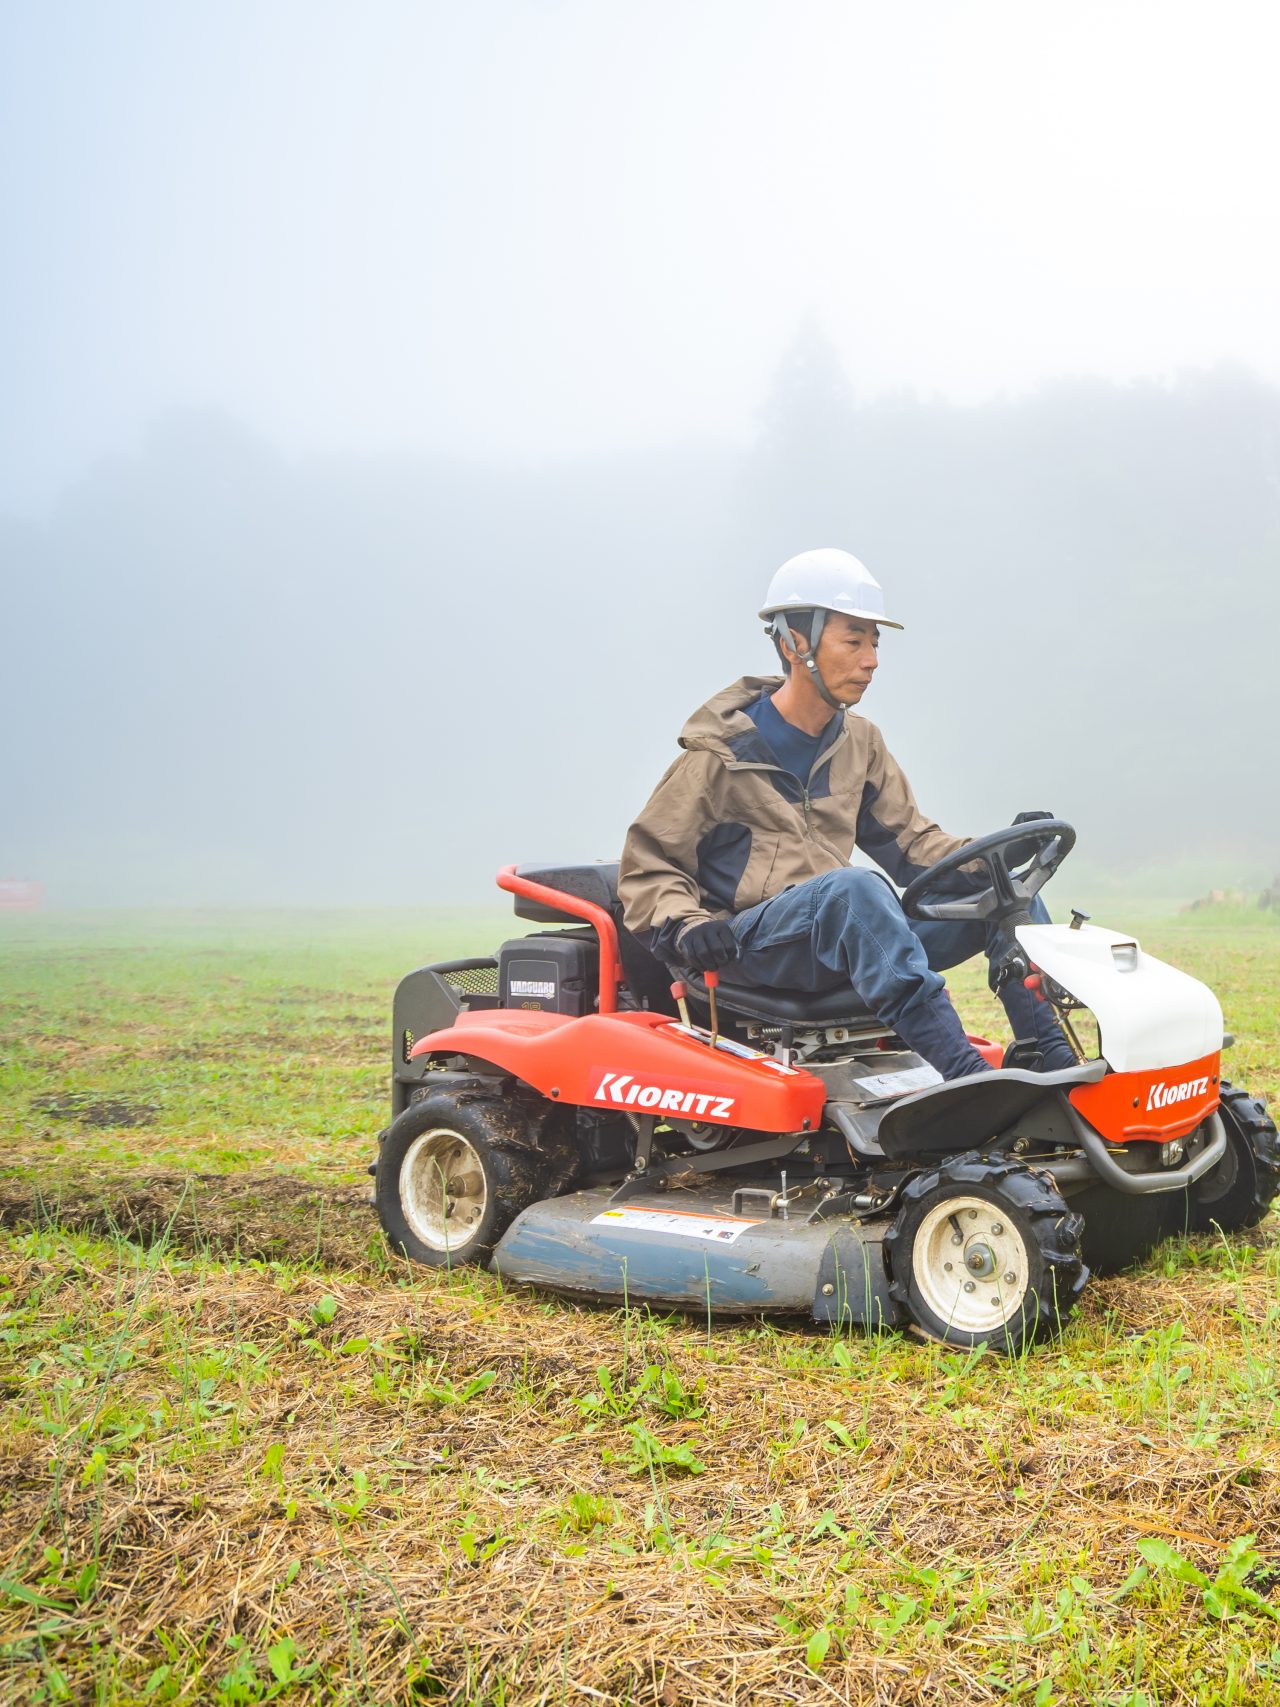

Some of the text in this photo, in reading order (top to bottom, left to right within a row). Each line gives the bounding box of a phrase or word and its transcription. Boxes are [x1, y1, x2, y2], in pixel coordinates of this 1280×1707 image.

[510, 980, 555, 994] VANGUARD
[594, 1073, 735, 1118] KIORITZ
[1146, 1076, 1209, 1112] KIORITZ
